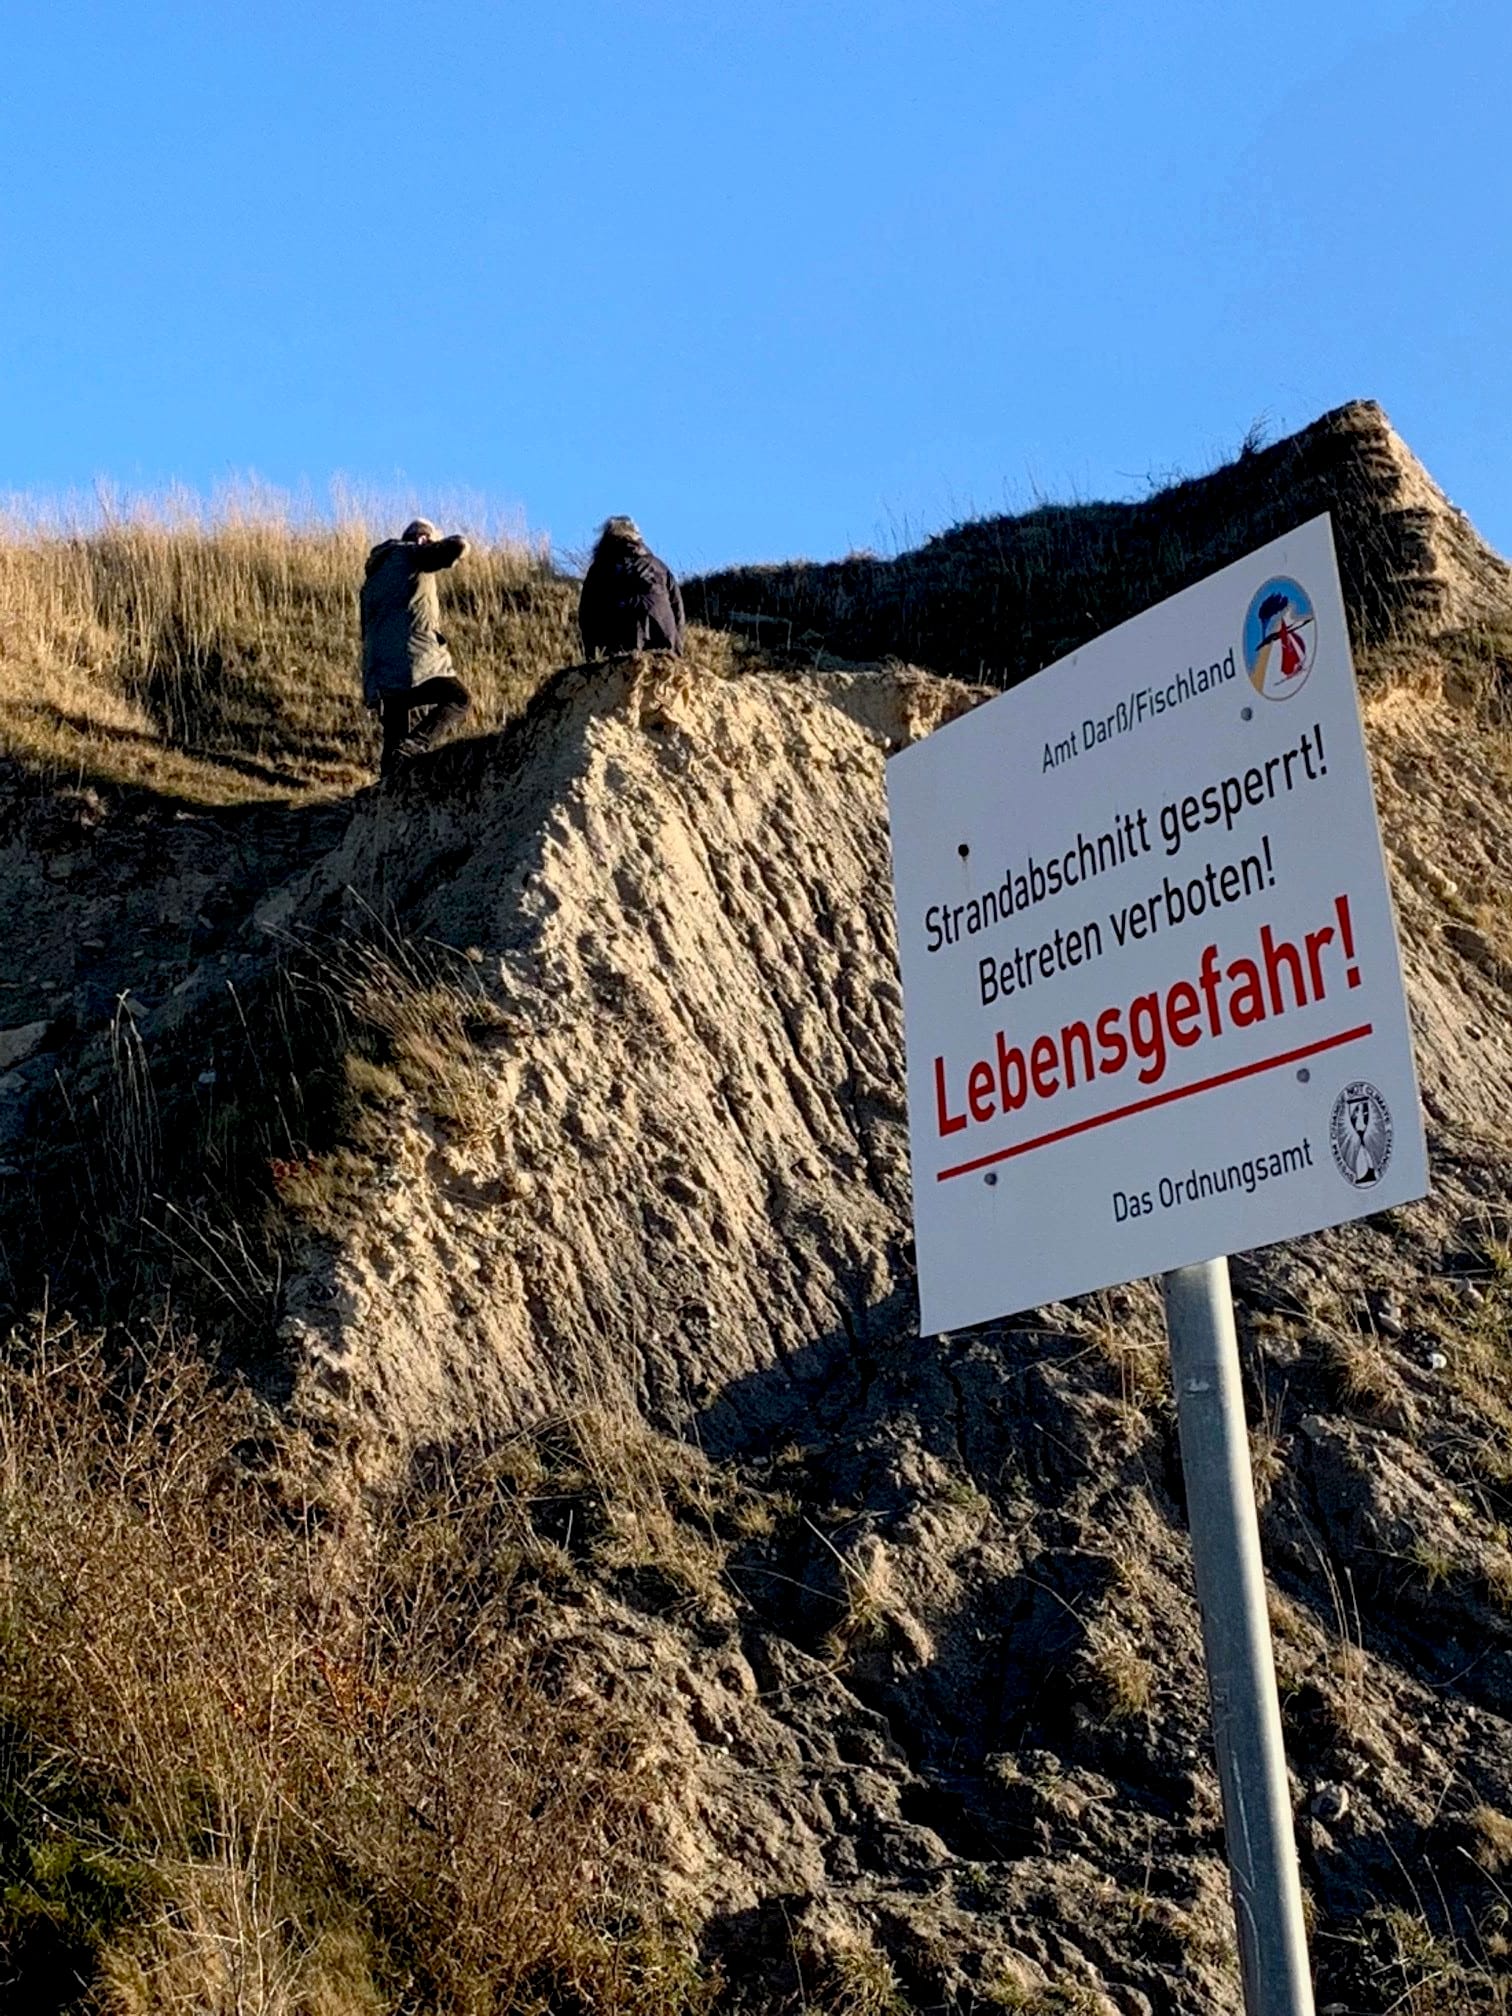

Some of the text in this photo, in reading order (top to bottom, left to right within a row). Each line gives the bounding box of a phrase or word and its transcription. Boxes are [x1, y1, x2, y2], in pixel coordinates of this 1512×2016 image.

[1042, 648, 1236, 774] Amt Darß/Fischland
[925, 723, 1328, 953] Strandabschnitt gesperrt!
[978, 834, 1276, 1006] Betreten verboten!
[934, 893, 1362, 1138] Lebensgefahr!
[1112, 1137, 1314, 1223] Das Ordnungsamt
